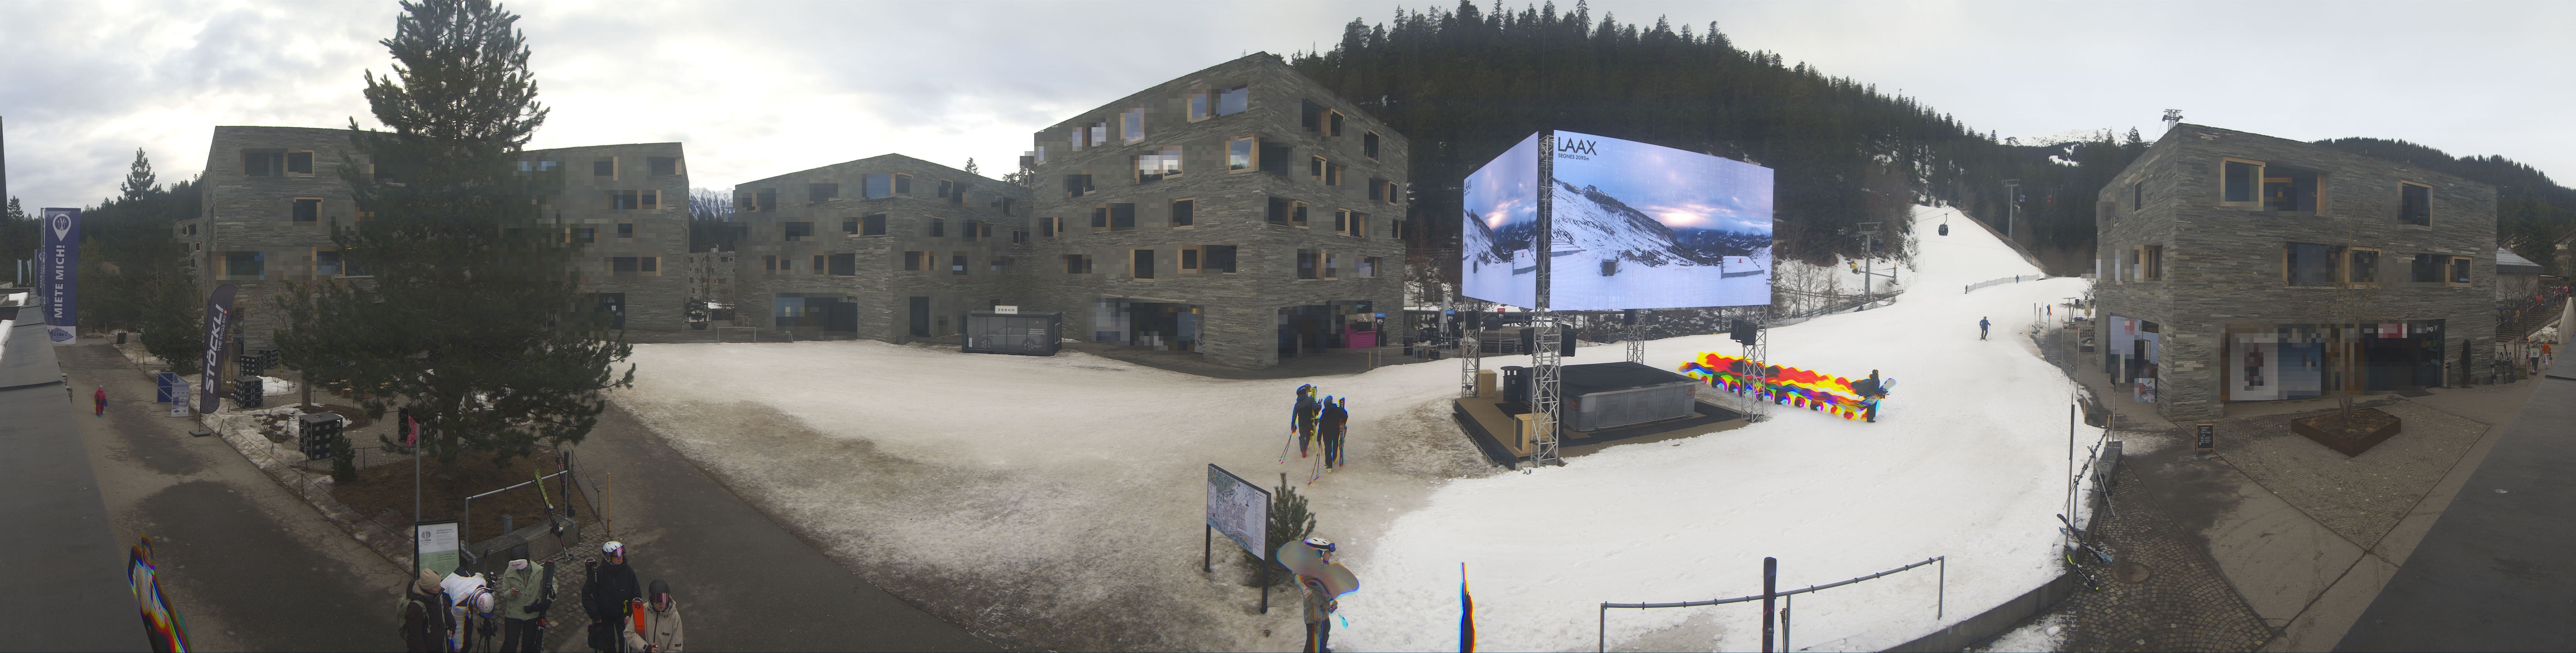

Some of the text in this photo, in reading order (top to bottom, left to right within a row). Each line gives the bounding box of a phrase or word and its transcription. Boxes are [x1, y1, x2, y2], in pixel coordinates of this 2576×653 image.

[1558, 137, 1597, 156] LAAX
[54, 245, 65, 318] MIETE MICH!
[205, 303, 224, 394] STÖCKLI
